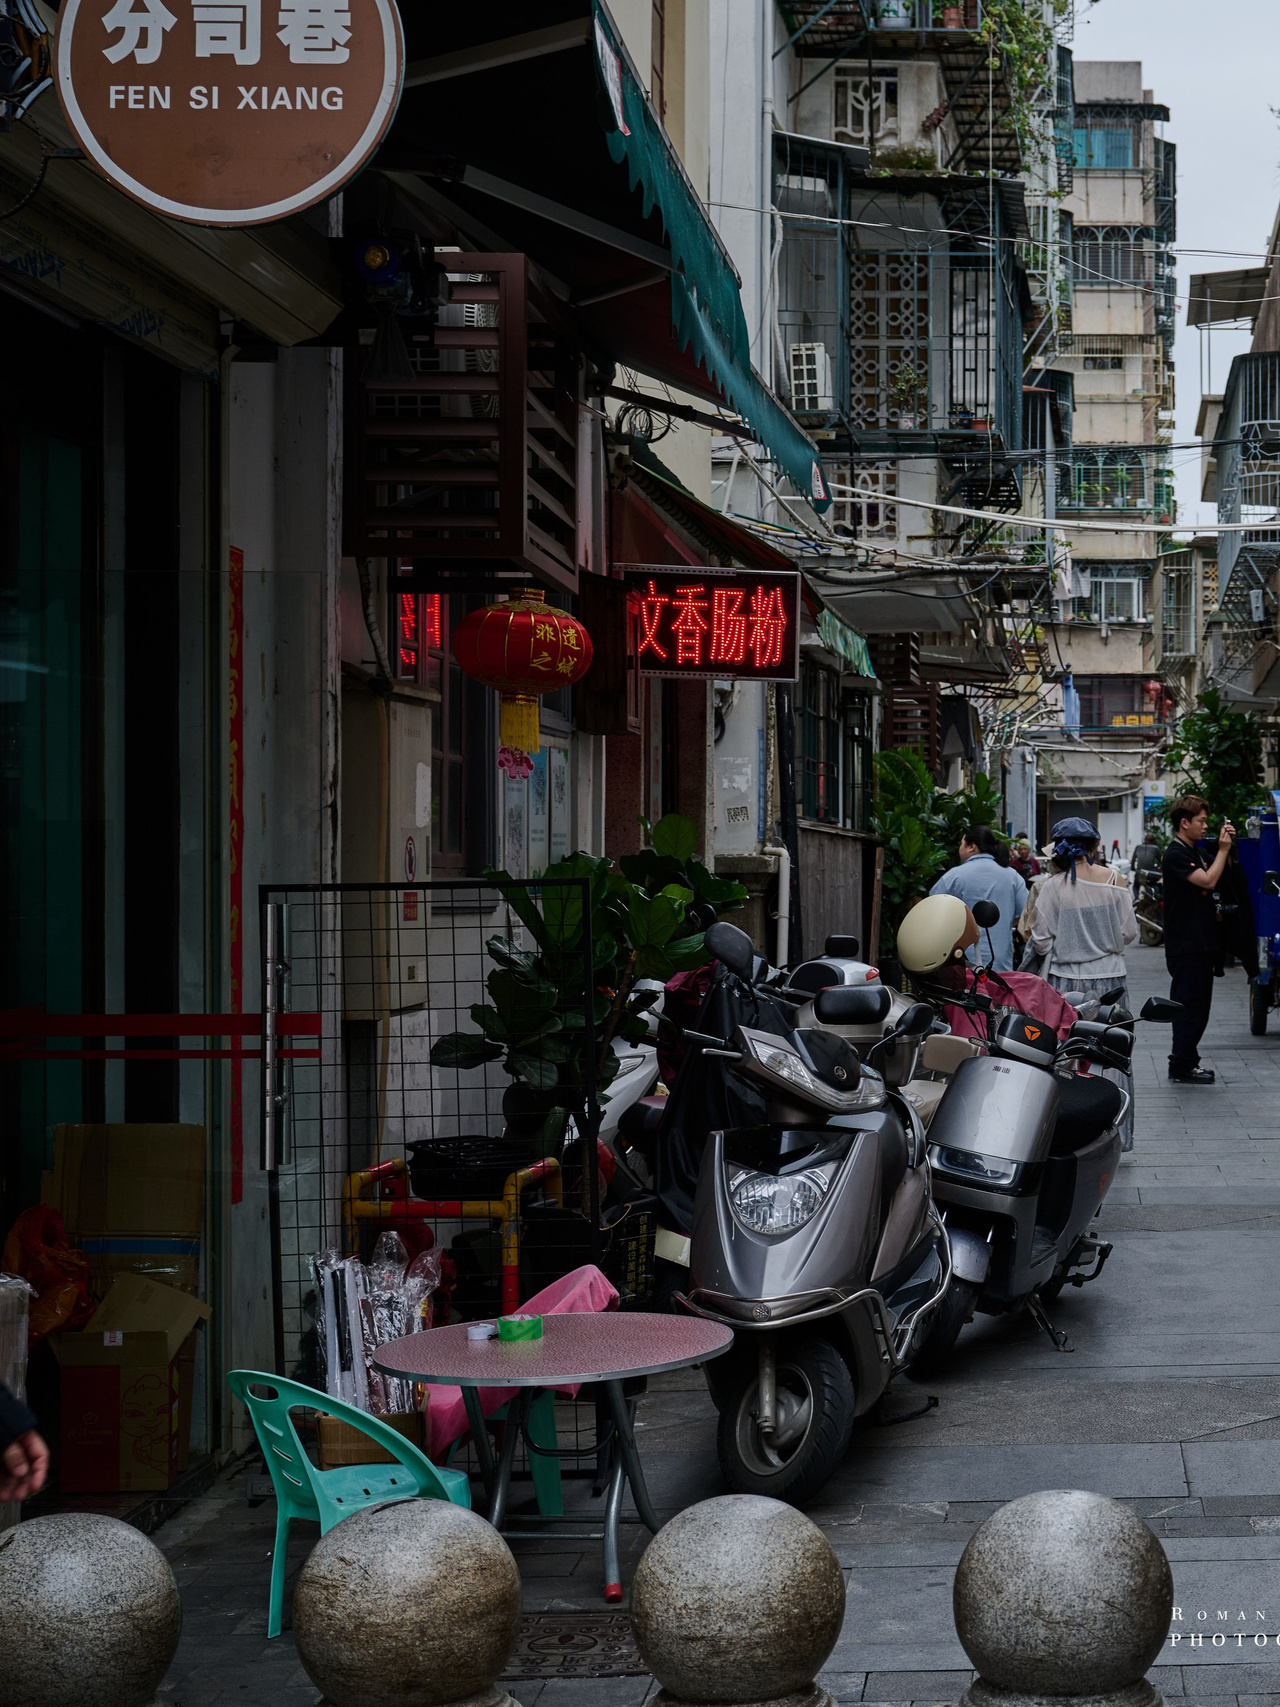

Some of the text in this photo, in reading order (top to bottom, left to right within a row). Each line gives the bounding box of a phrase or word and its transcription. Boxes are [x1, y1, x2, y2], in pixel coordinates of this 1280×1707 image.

[101, 0, 352, 66] 分司巷
[108, 85, 346, 112] FEN SI XIANG
[639, 578, 788, 668] 文香肠粉
